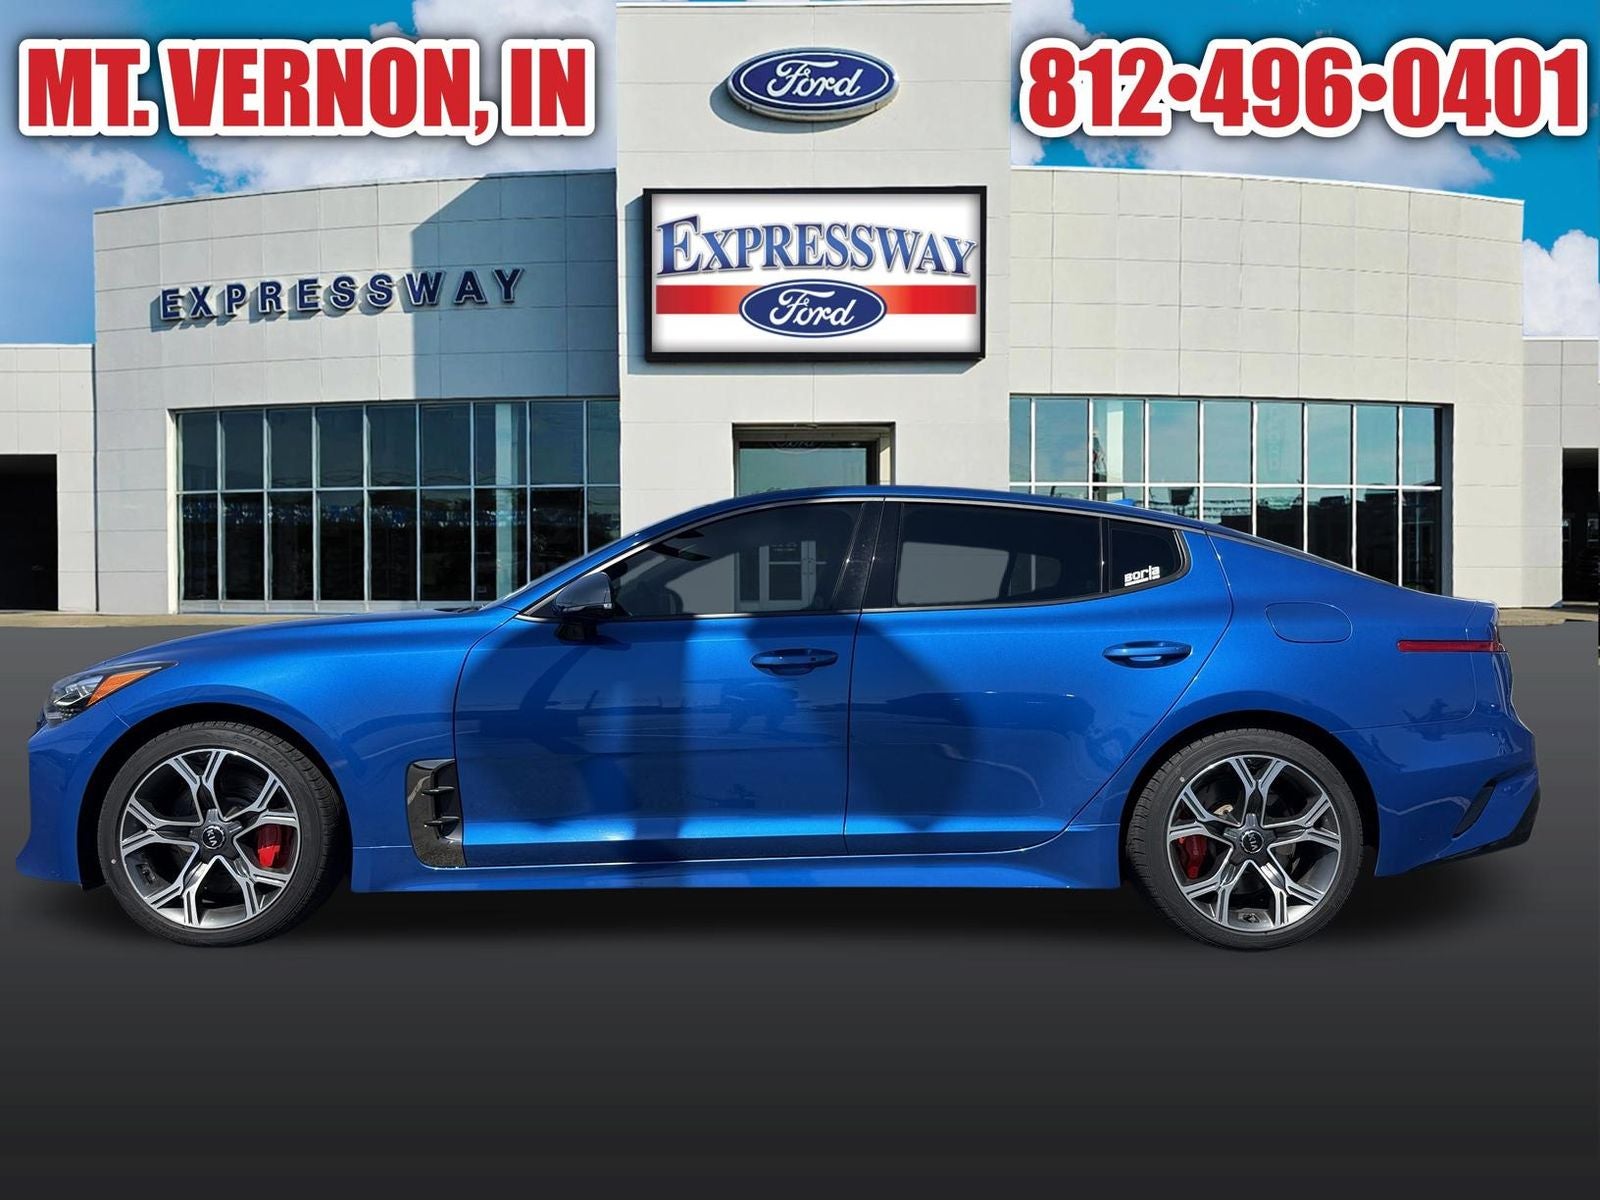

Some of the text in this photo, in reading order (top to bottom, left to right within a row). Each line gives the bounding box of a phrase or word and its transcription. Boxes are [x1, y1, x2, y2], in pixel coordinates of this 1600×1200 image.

[766, 60, 864, 97] Ford
[656, 215, 977, 277] EXPRESSWAY
[160, 268, 524, 322] EXPRESSWAY
[769, 288, 856, 326] Ford
[206, 829, 218, 847] KIA
